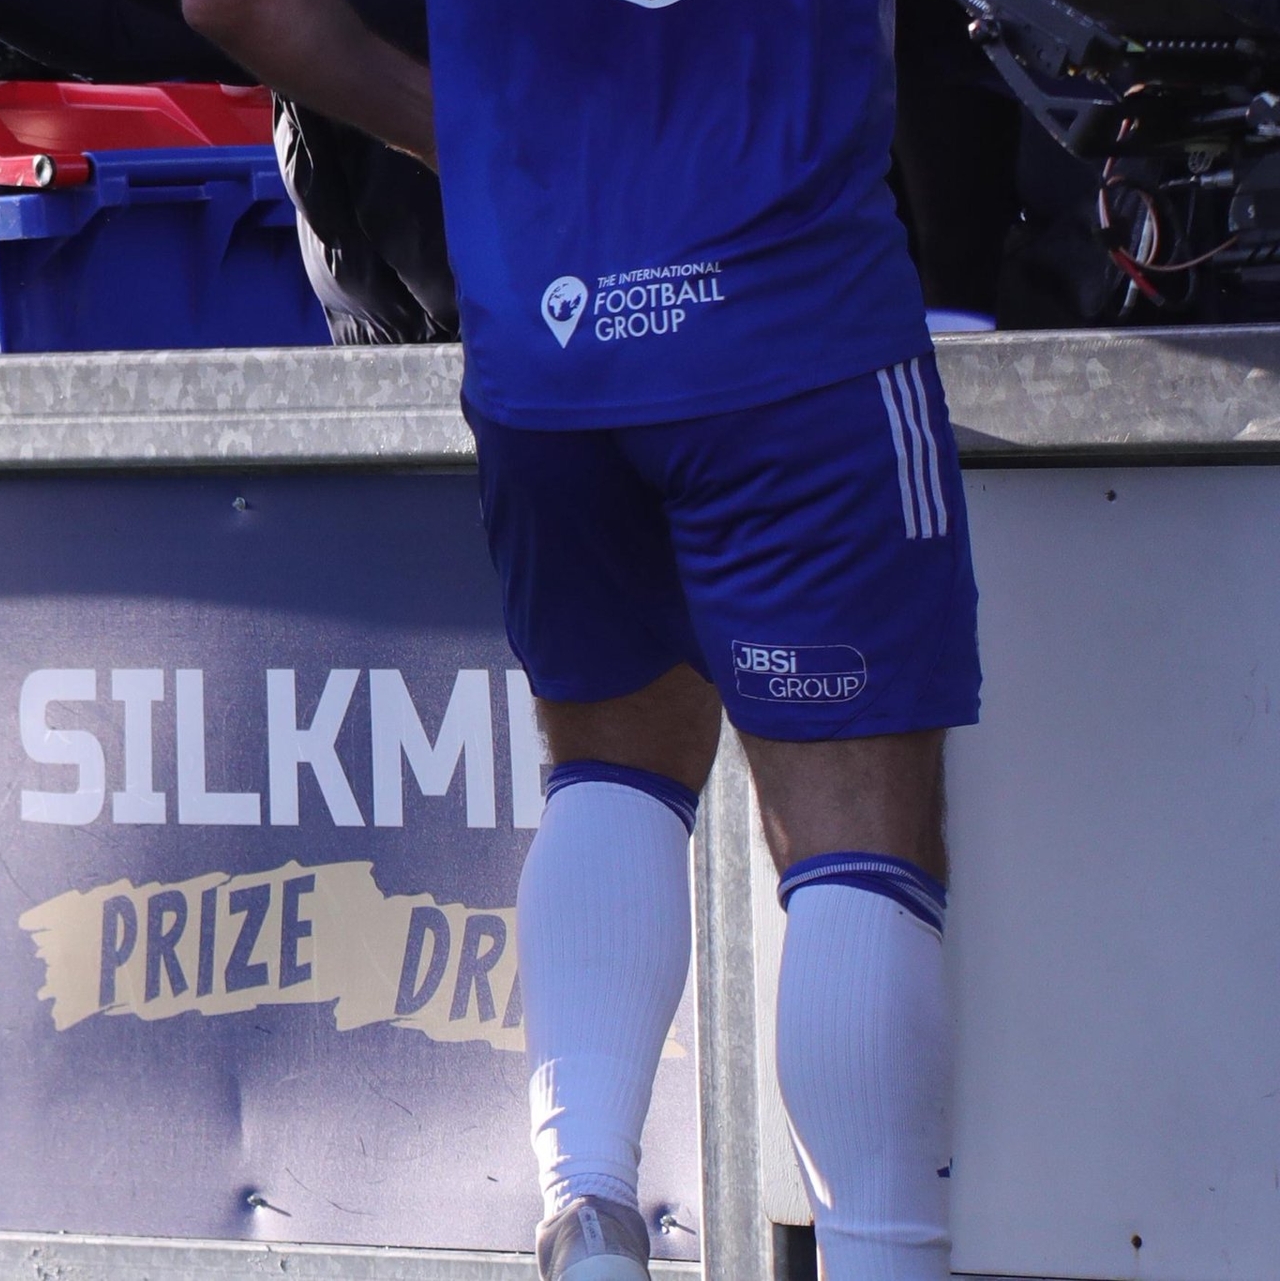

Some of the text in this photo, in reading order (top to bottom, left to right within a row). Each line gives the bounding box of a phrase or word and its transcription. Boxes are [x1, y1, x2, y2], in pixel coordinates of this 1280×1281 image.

[597, 262, 722, 289] THE INTERNATIONAL
[594, 278, 725, 315] FOOTBALL
[595, 309, 686, 341] GROUP
[736, 647, 797, 673] JBSi
[769, 676, 859, 698] GROUP
[99, 873, 316, 1009] PRIZE
